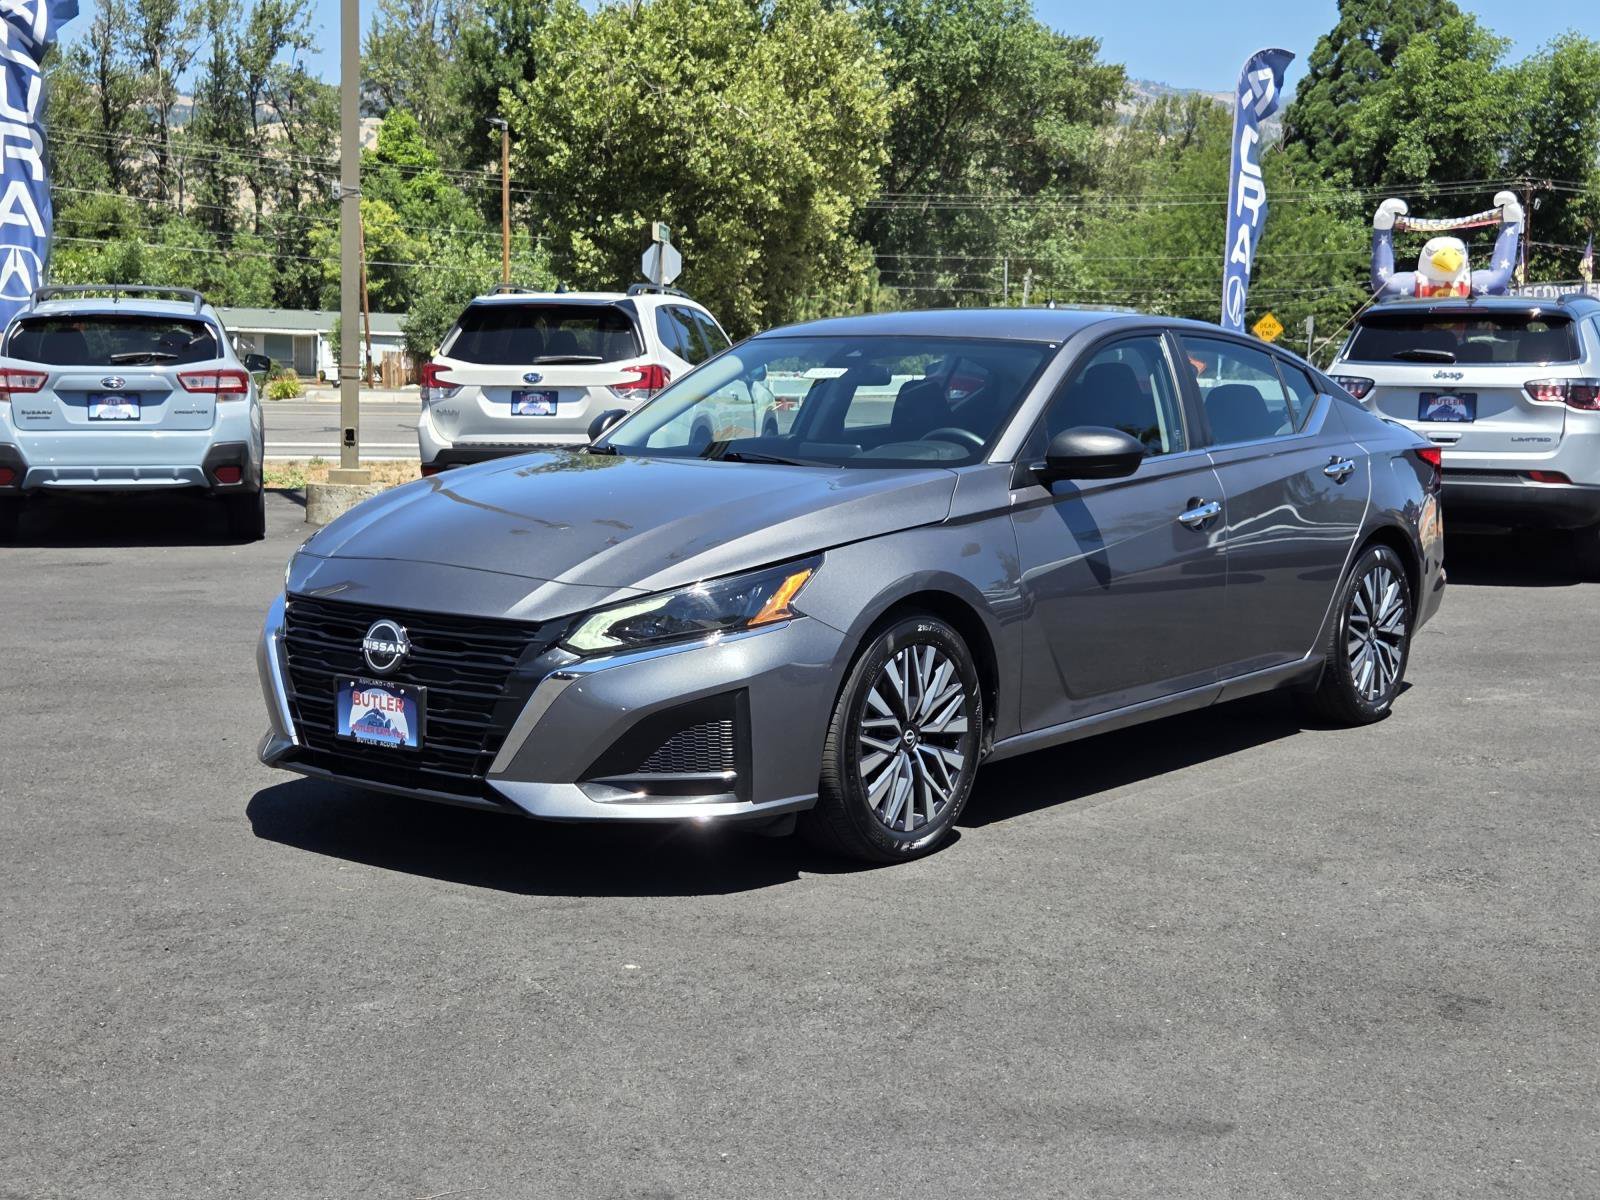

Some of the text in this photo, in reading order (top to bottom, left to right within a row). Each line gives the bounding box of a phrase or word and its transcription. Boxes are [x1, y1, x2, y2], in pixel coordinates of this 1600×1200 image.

[1432, 369, 1464, 381] Jeep
[363, 639, 405, 654] NISSAN
[353, 690, 404, 712] BUTLER
[356, 736, 398, 749] BUTLER ACURA
